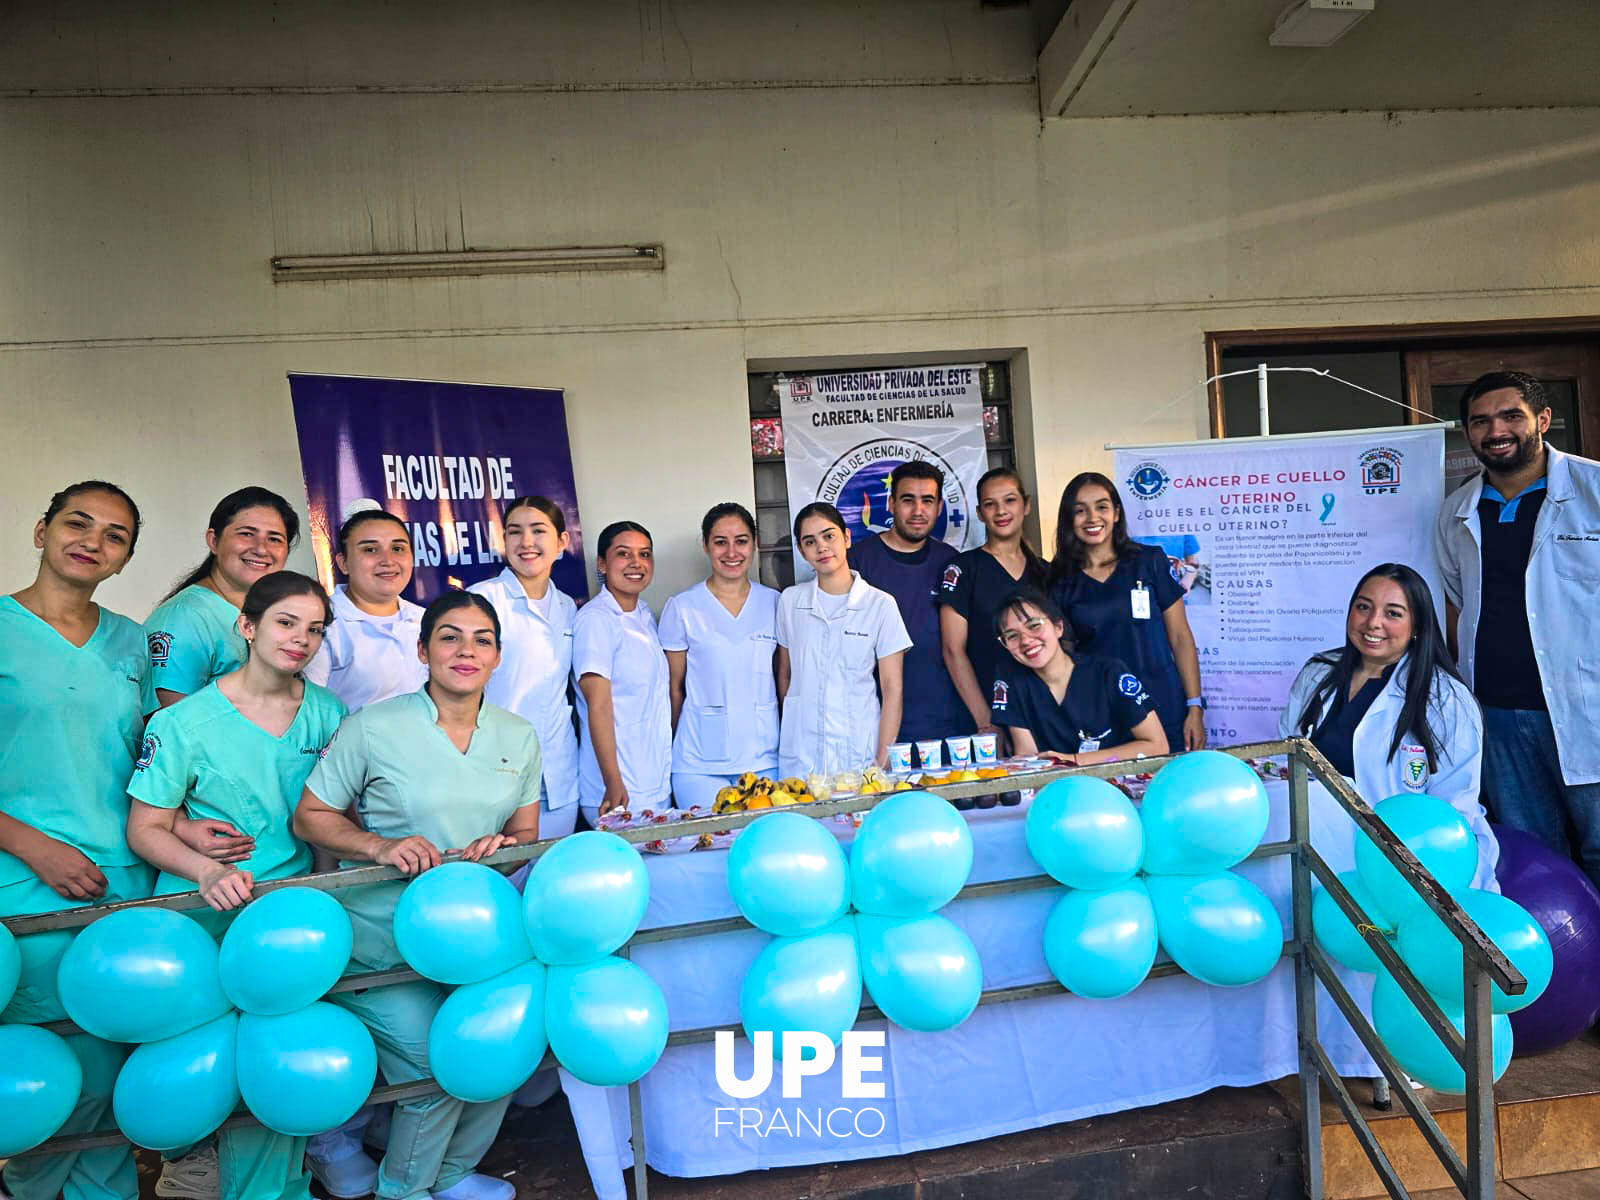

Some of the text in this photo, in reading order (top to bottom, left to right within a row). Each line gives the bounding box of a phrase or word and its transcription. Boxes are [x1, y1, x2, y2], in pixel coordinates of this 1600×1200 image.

[817, 369, 972, 392] UNIVERSIDAD PRIVADA DEL ESTE
[826, 393, 865, 403] FACULTAD
[879, 390, 916, 400] CIENCIAS
[918, 389, 928, 398] DE
[929, 388, 939, 396] LA
[941, 387, 966, 396] SALUD
[812, 401, 954, 427] CARRERA: ENFERMERÍA
[382, 454, 516, 500] FACULTAD DE
[823, 465, 851, 504] CULTAD
[848, 454, 865, 469] DE
[864, 445, 912, 461] CIENCIAS
[1173, 470, 1345, 489] CÁNCER DE CUELLO
[1220, 492, 1296, 505] UTERINO
[1365, 487, 1398, 495] UPE
[1177, 507, 1193, 517] ES
[1200, 507, 1214, 516] EL
[1286, 503, 1312, 513] DEL
[1158, 520, 1288, 533] CUELLO UTERINO?
[474, 521, 503, 564] LA
[1216, 579, 1273, 589] CAUSAS
